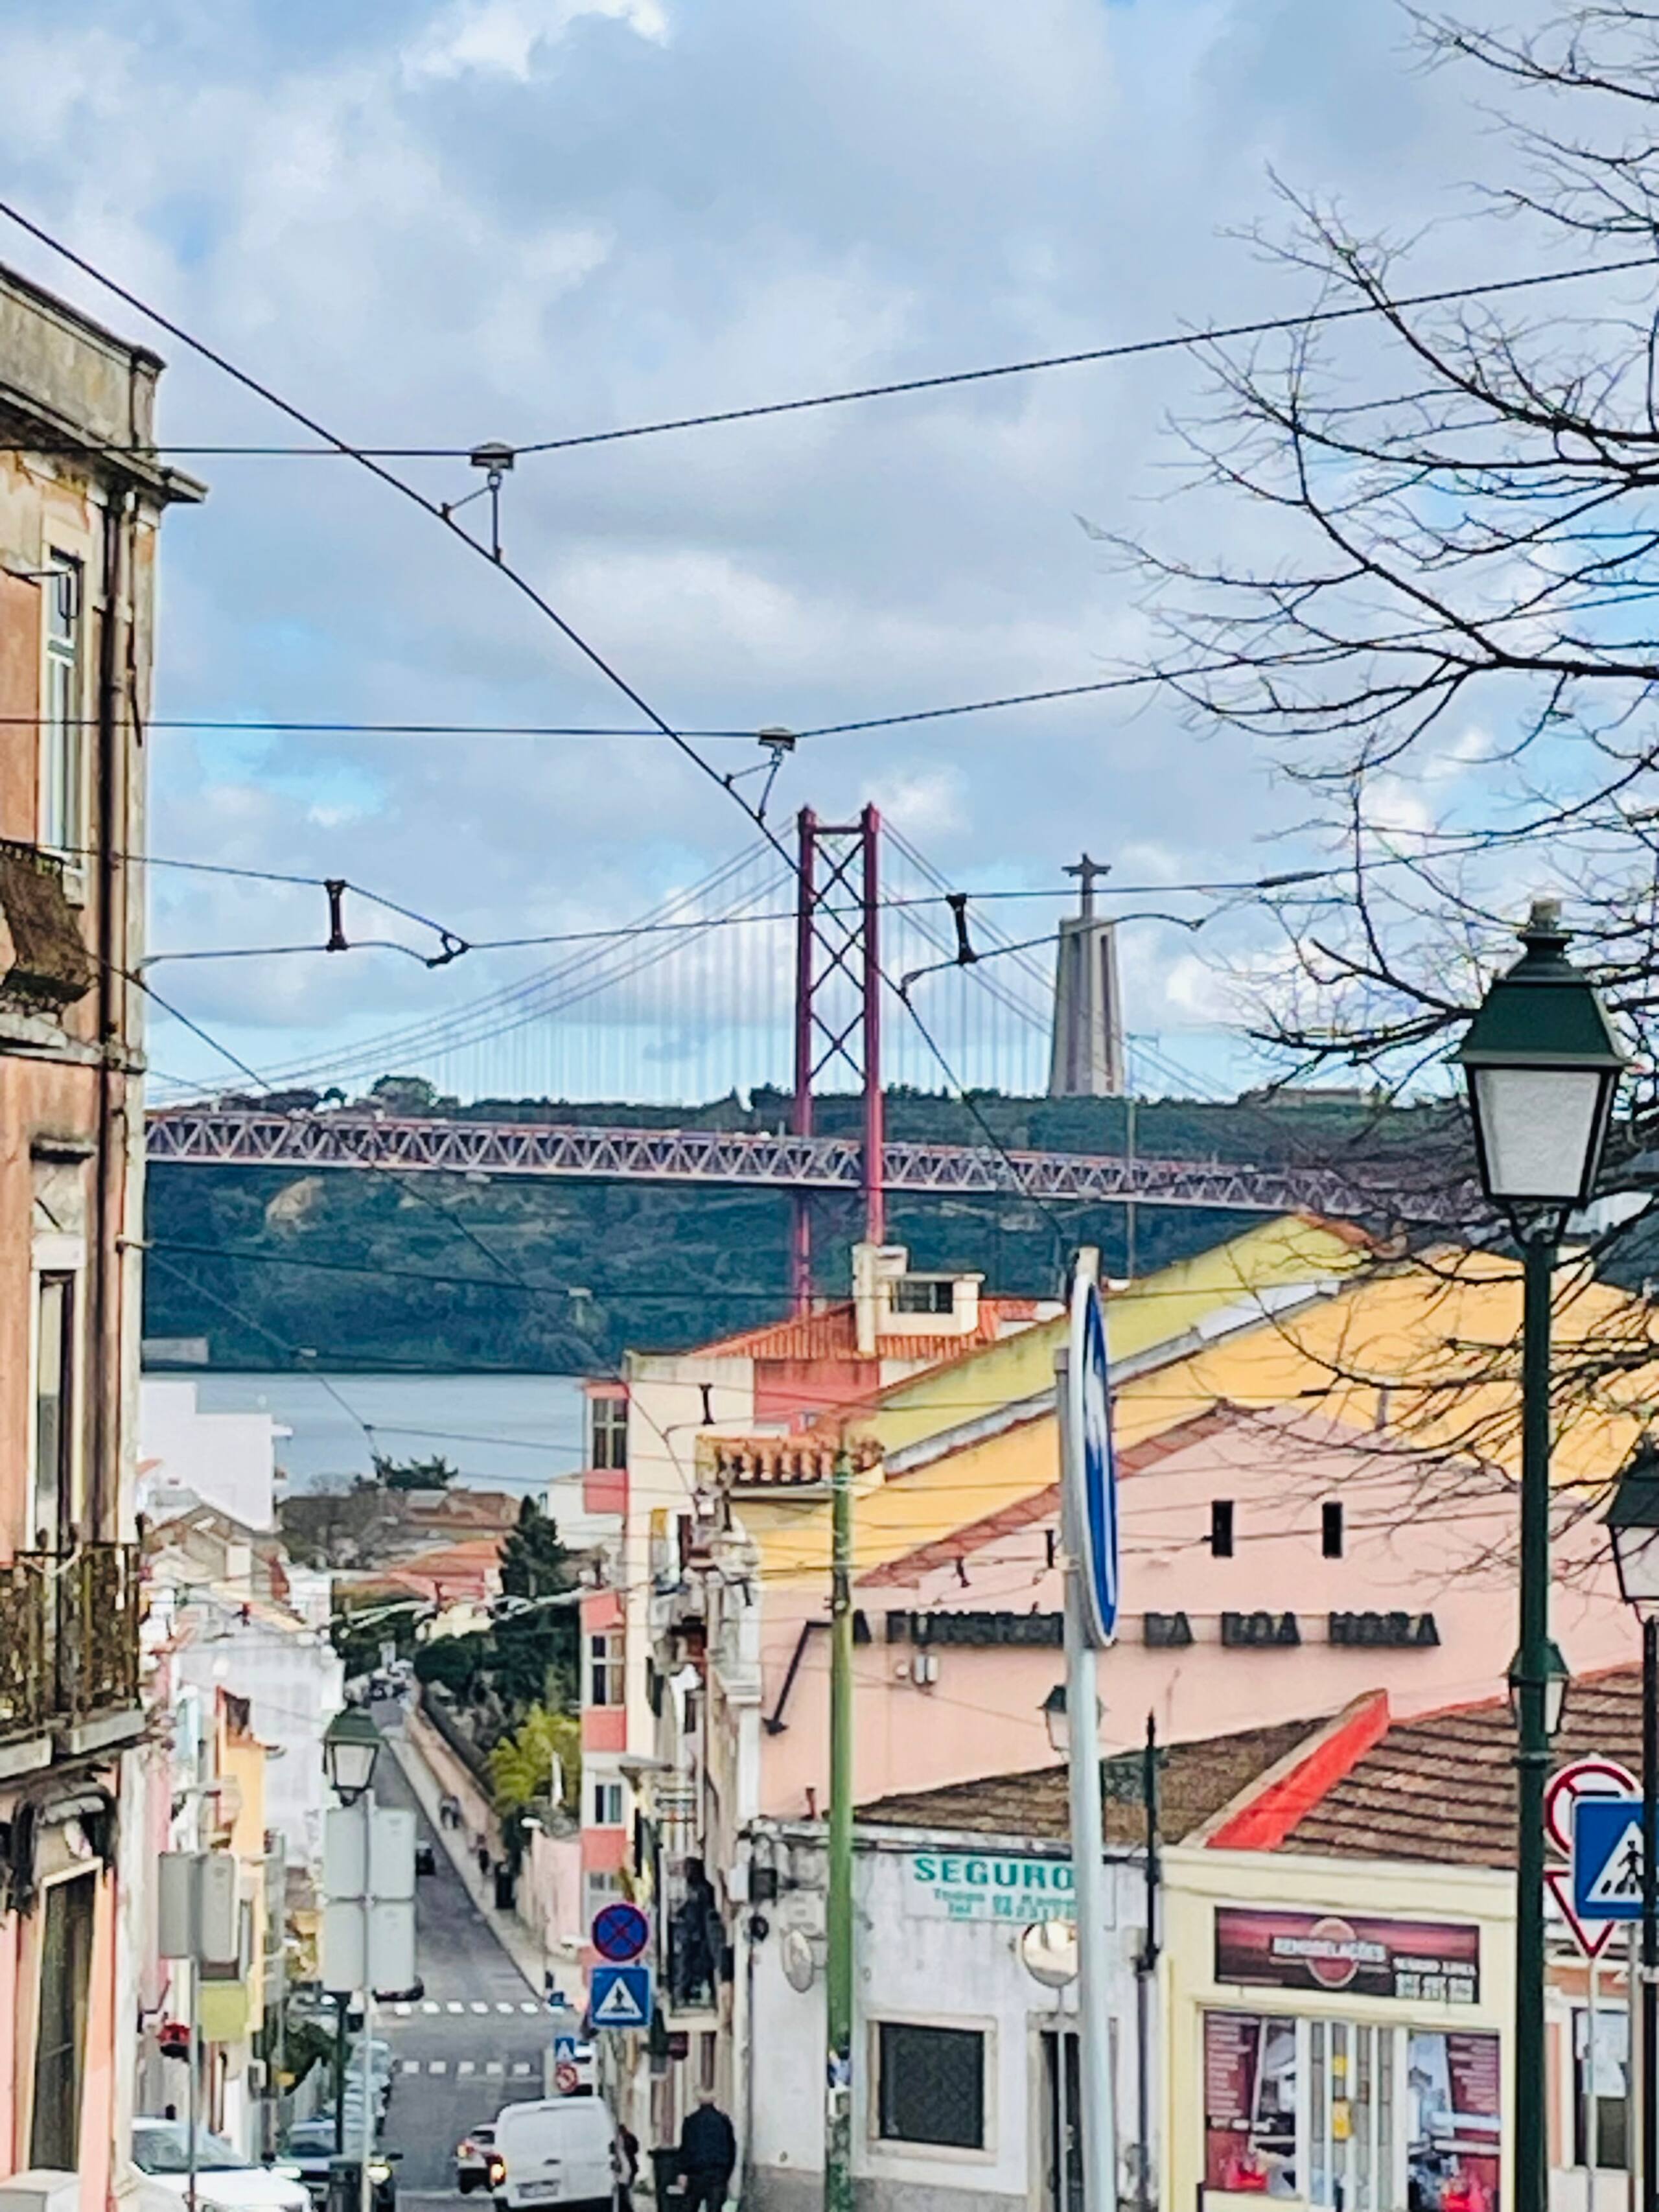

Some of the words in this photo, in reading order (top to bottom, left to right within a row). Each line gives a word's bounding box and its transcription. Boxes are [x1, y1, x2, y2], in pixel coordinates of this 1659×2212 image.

[1144, 1611, 1194, 1646] DA
[1221, 1611, 1301, 1646] BOA
[1328, 1611, 1441, 1646] HORA
[914, 1856, 1075, 1891] SEGURO
